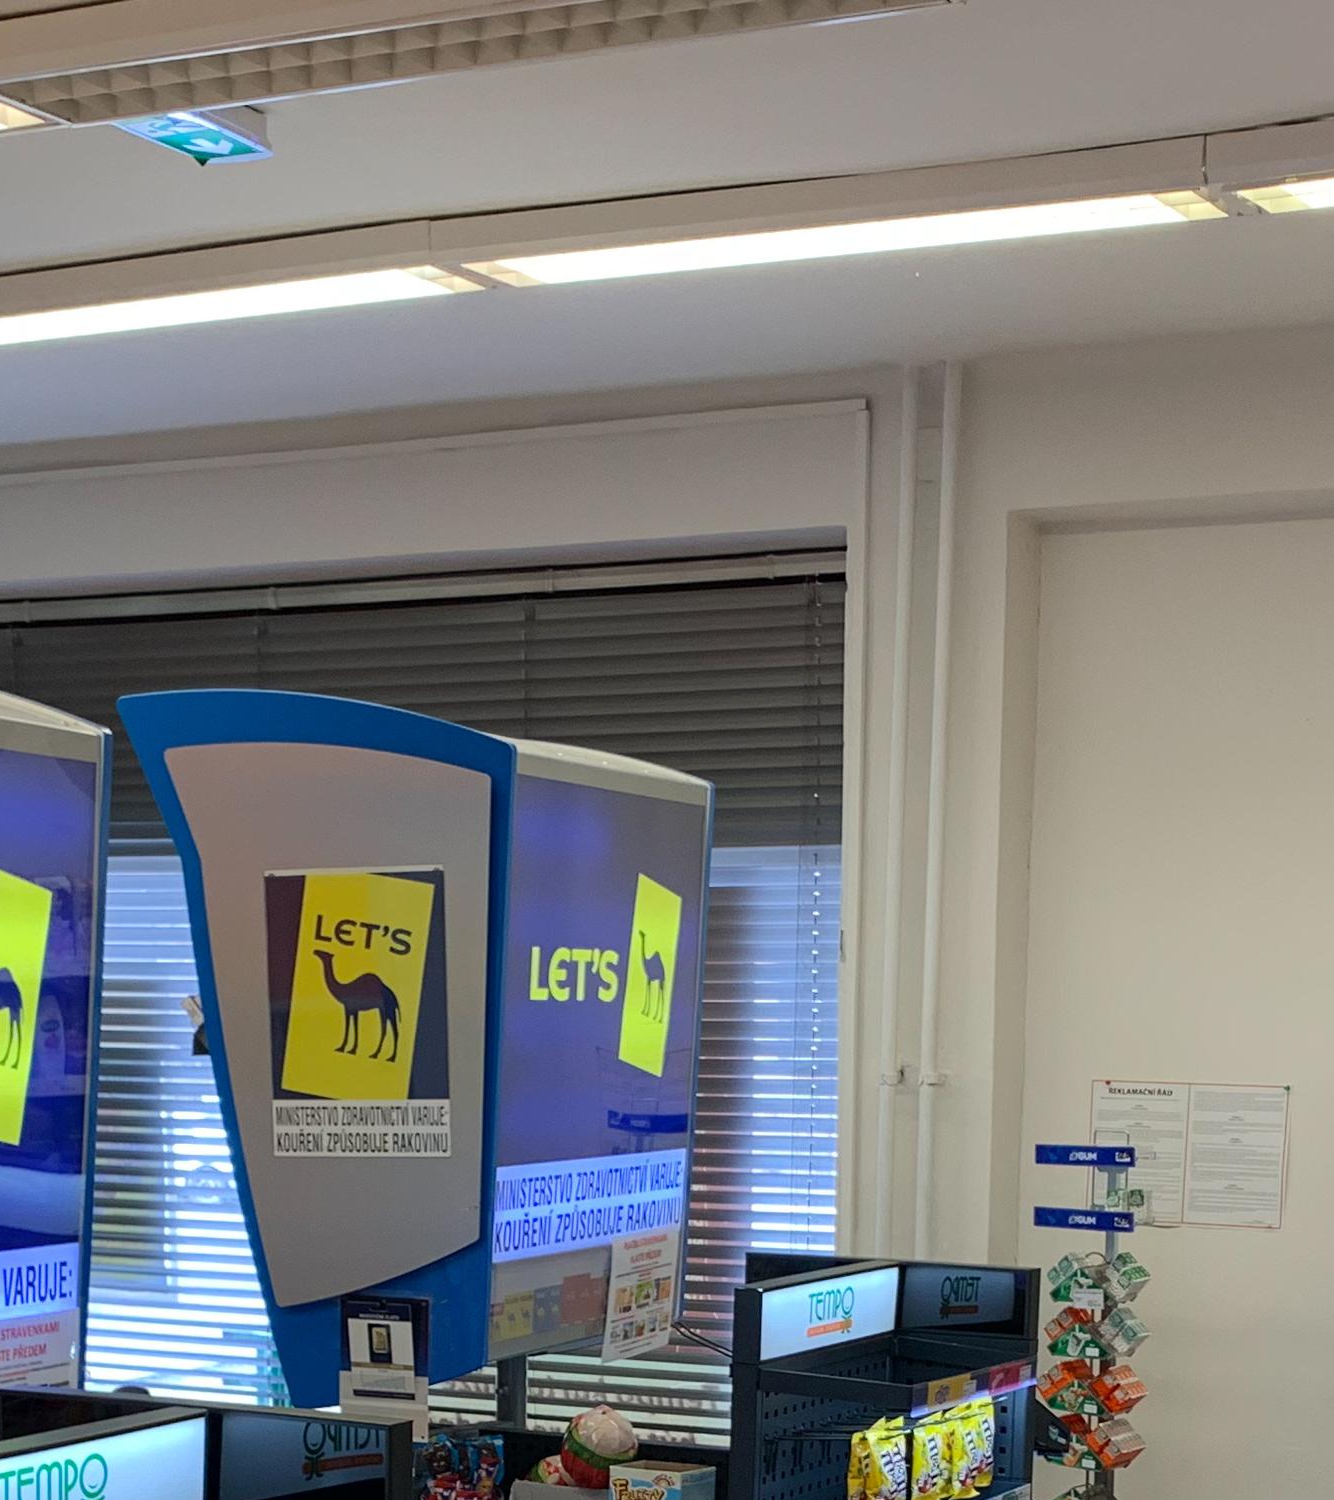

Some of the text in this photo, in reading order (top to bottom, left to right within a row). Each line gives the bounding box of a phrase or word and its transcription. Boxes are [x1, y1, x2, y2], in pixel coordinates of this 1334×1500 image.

[315, 914, 413, 956] LET'S
[529, 945, 619, 1003] LET'S
[1108, 1087, 1156, 1097] REKLAMAČNÍ
[276, 1106, 339, 1127] MINISTERSTVO
[341, 1102, 410, 1127] ZDRAVOTNICTVÍ
[276, 1128, 449, 1154] KOUŘENÍ ZPŮSOBUJE RAKOVINU
[495, 1172, 572, 1212] MINISTERSTVO
[575, 1160, 647, 1201] ZDRAVOTNICTVÍ
[494, 1197, 681, 1254] KOUŘENÍ ZPŮSOBUJE RAKOVINU
[2, 1261, 73, 1304] VARUJE:
[809, 1286, 855, 1323] TEMPO
[1, 1321, 61, 1344] STRAVENKAMI
[12, 1343, 47, 1363] PŘEDEM
